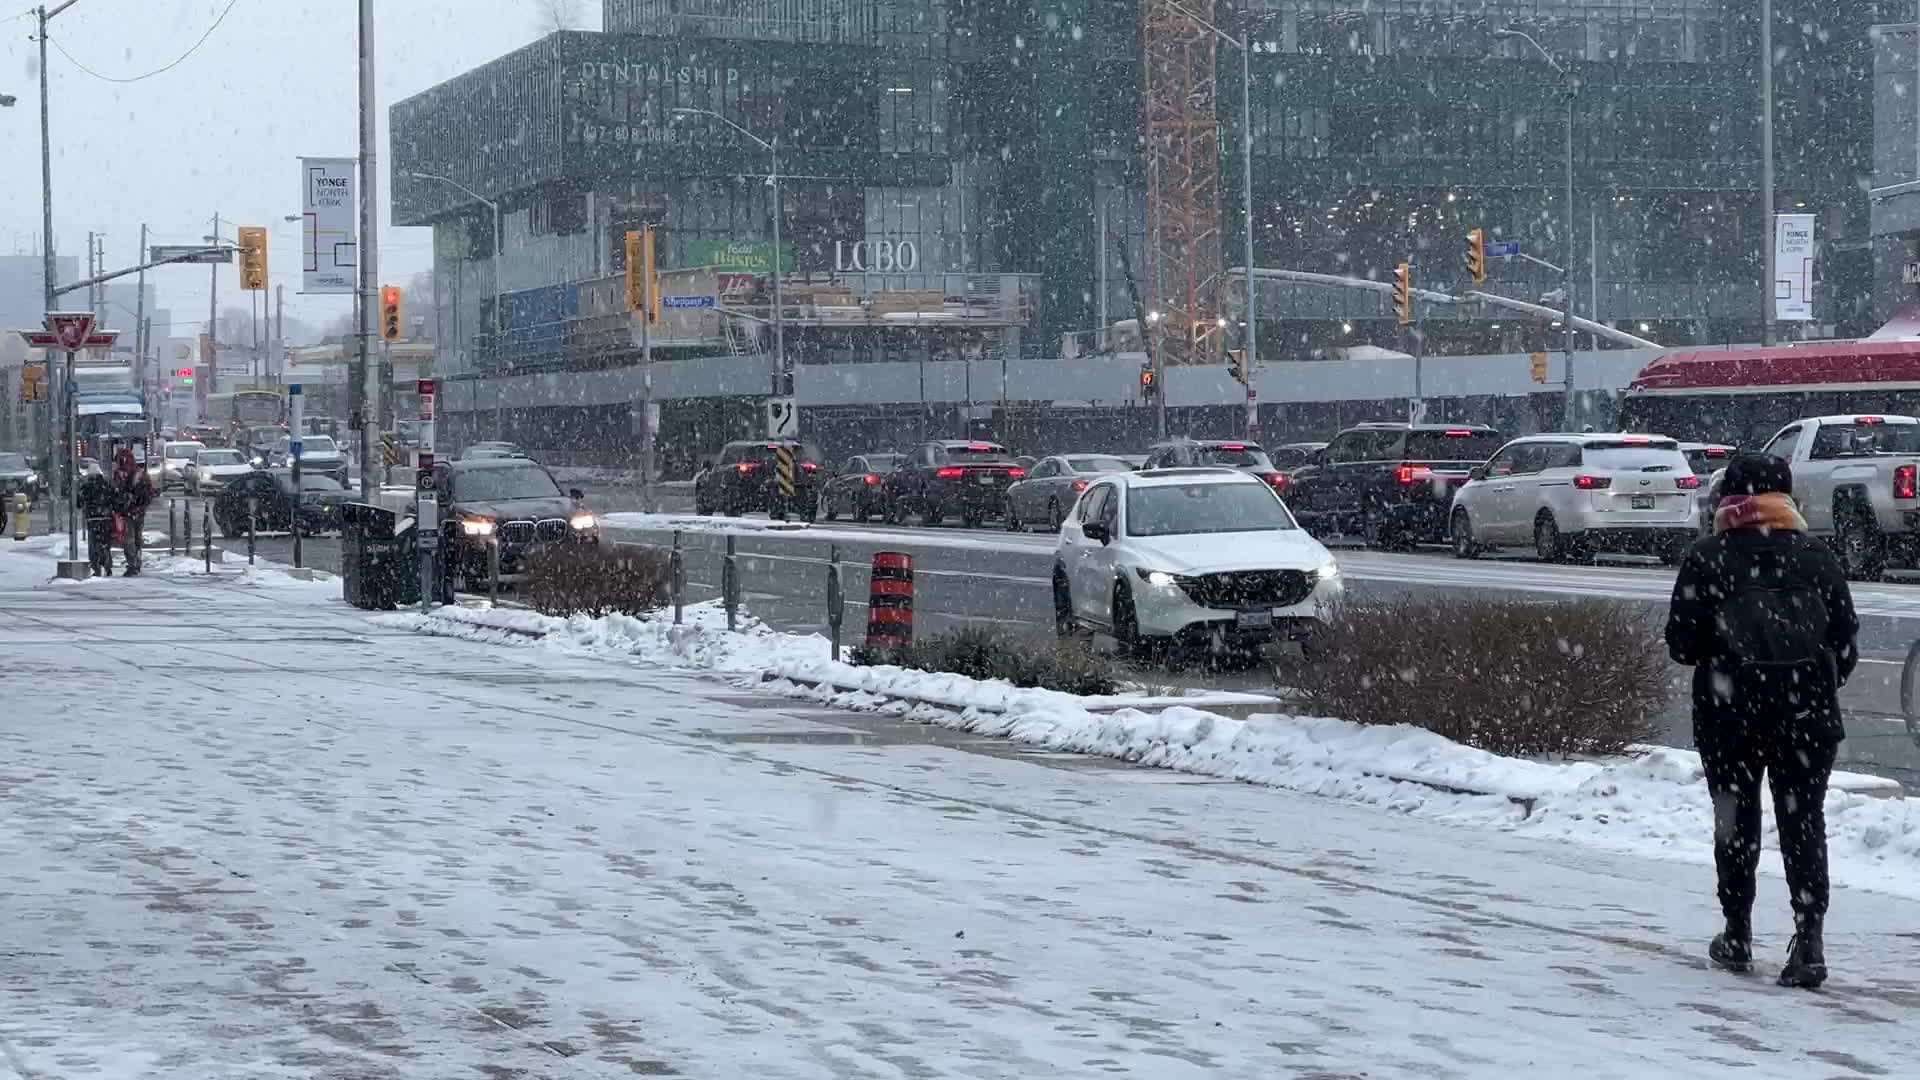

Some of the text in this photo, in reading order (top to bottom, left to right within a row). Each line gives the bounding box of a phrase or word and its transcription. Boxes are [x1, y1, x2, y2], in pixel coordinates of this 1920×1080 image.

[583, 61, 738, 85] DENTALSHIP
[316, 178, 347, 187] YONGE
[836, 240, 917, 272] LCBO
